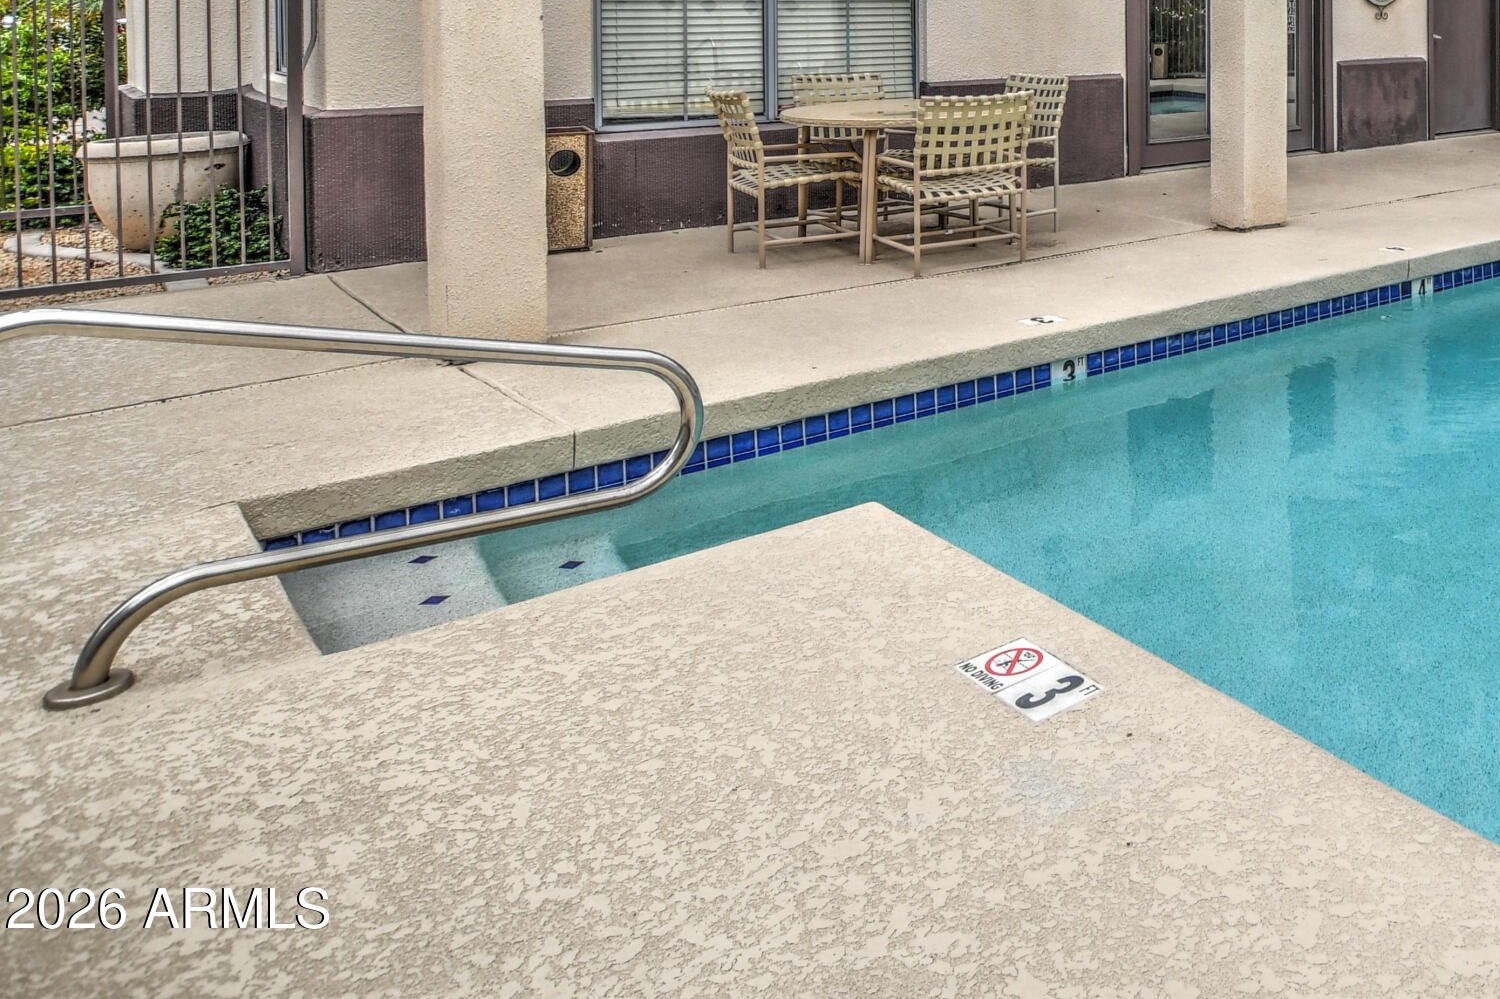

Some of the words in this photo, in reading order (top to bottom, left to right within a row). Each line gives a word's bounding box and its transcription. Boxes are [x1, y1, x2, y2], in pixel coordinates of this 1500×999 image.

[1063, 360, 1076, 381] 3
[959, 662, 975, 672] NO
[971, 669, 1004, 690] DIVING
[1015, 675, 1084, 709] 3
